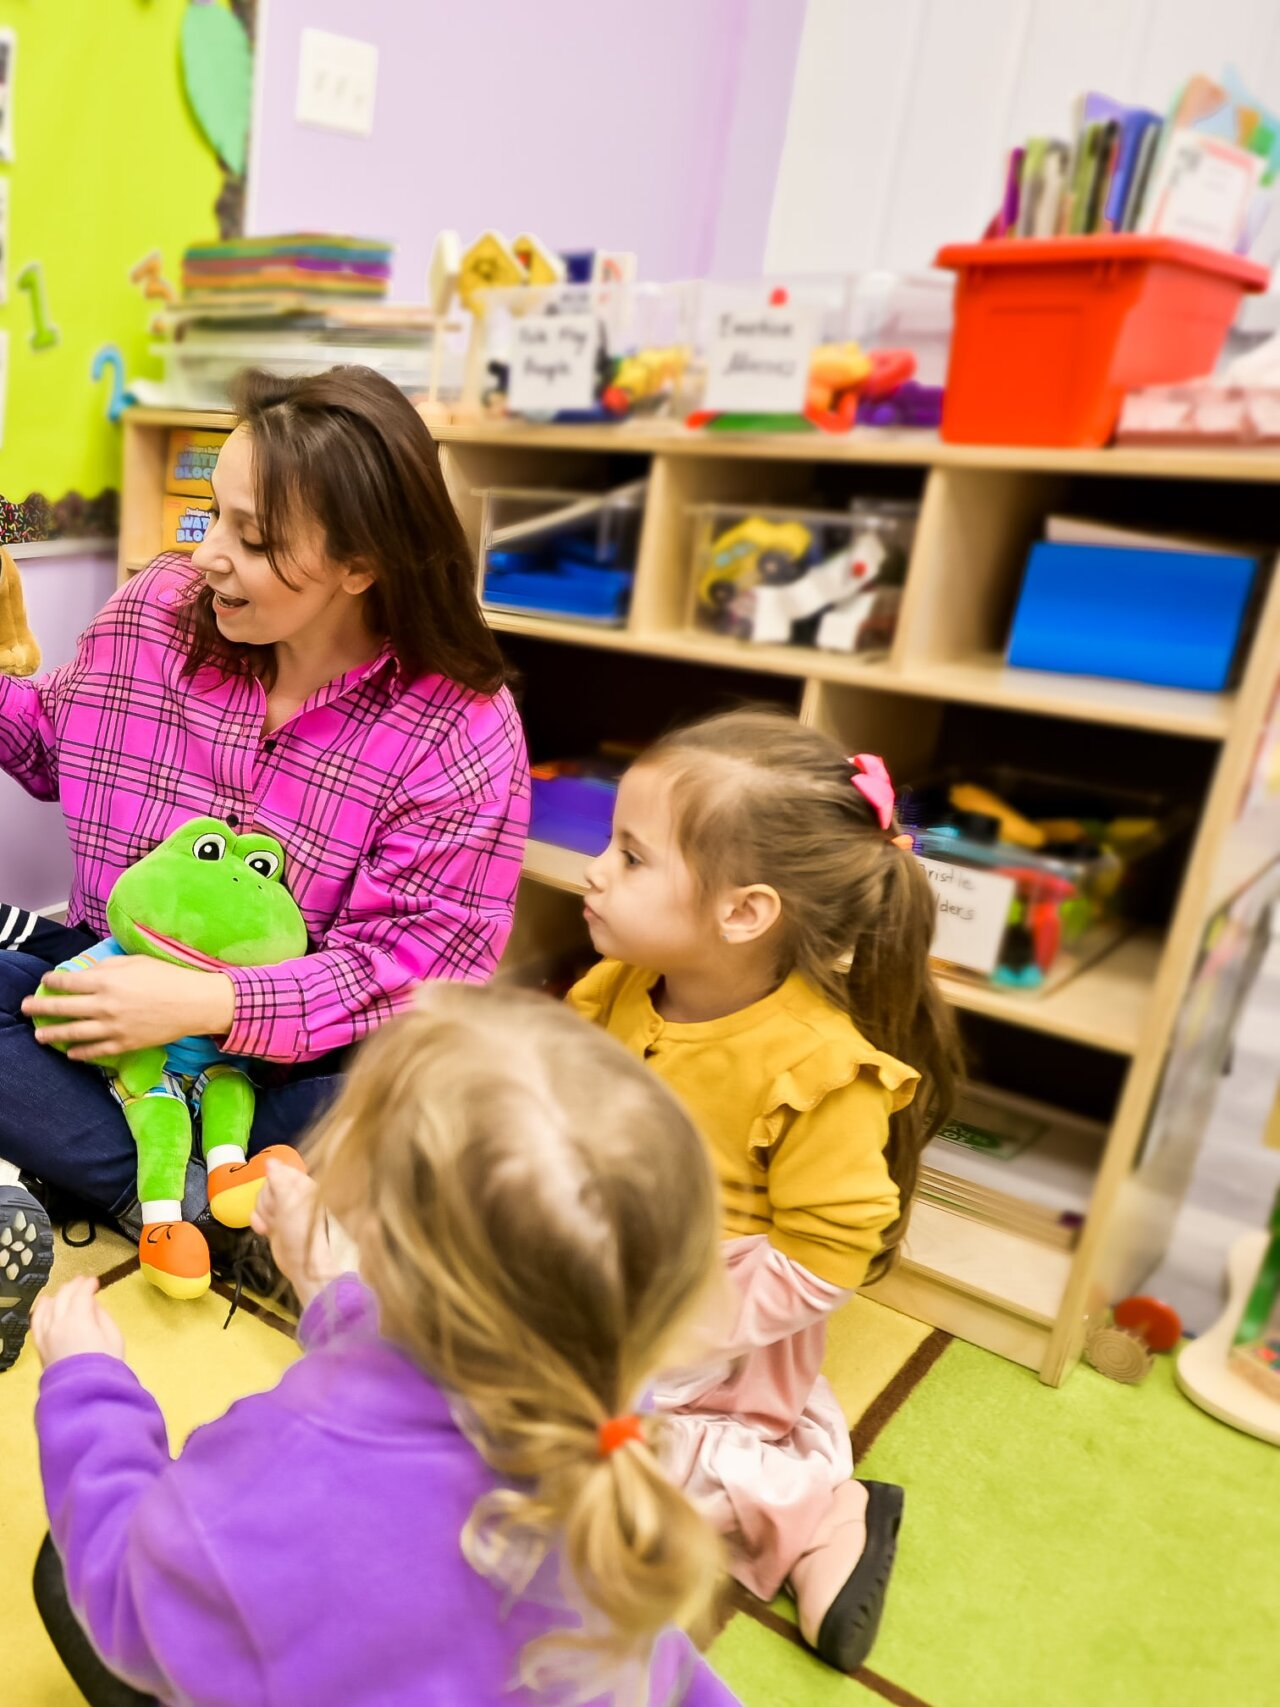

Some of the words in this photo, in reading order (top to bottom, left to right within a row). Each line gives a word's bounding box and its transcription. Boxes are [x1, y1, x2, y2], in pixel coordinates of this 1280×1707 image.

[17, 260, 58, 351] 1
[91, 345, 137, 422] 2
[178, 453, 217, 468] WATE
[175, 466, 212, 480] BLOC
[180, 515, 209, 529] WAT
[176, 528, 204, 543] BLO
[919, 863, 977, 891] ristle
[935, 892, 976, 921] lders
